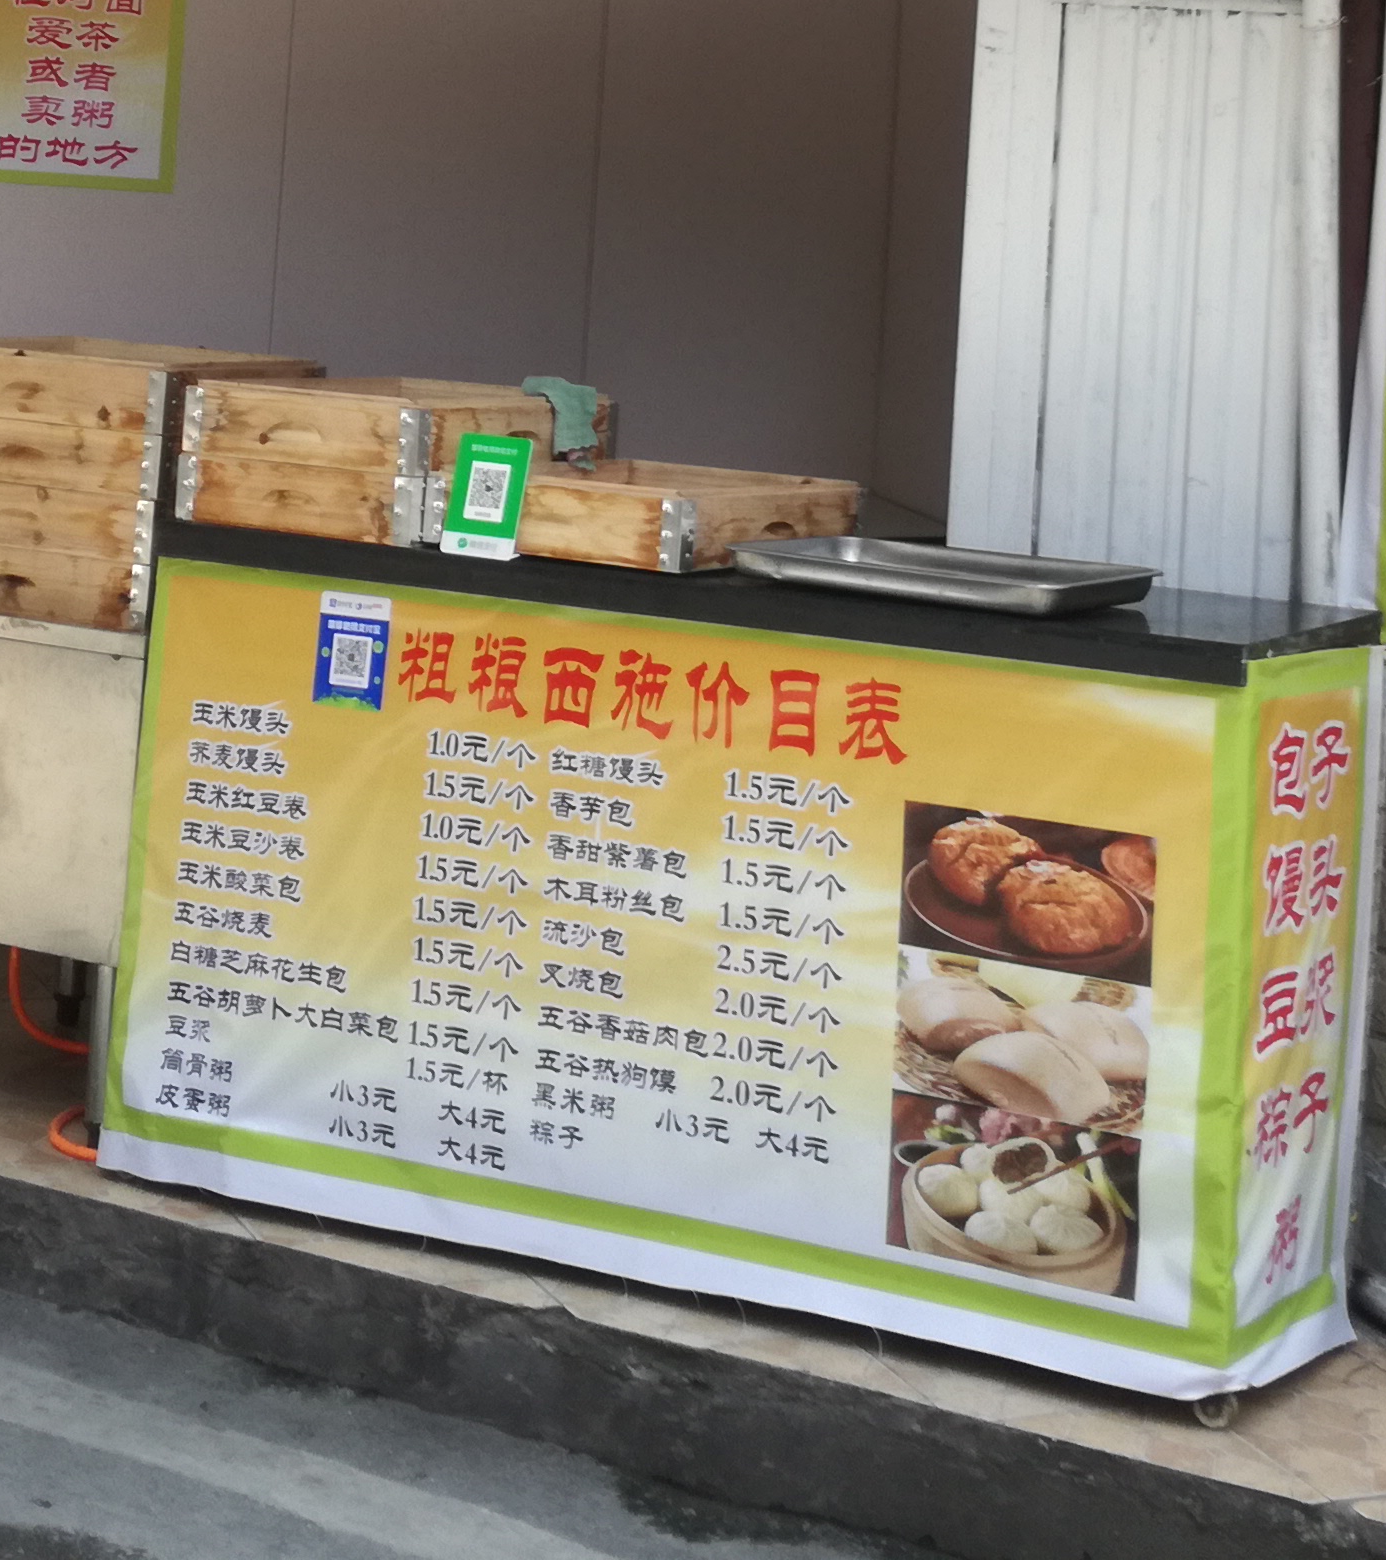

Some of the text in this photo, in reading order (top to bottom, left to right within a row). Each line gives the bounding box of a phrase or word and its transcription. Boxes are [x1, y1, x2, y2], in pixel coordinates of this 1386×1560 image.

[26, 16, 120, 52] 爱茶
[26, 56, 117, 92] 或者
[21, 95, 115, 129] 卖粥
[398, 628, 907, 765] 粗粮西施价目表
[193, 702, 536, 768] 玉米馒头 1.0元/个
[1272, 726, 1348, 814] 包子
[189, 741, 534, 810] 荞麦馒头 1.5元/个
[551, 748, 850, 813] 红糖馒头 1.5元/个
[186, 781, 531, 852] 玉米红豆卷 1.0元/个
[550, 791, 849, 857] 香芋包 1.5元/个
[181, 821, 528, 894] 玉米豆沙卷 1.5元/个
[547, 834, 847, 901] 香甜紫薯包 1.5元/个
[1266, 840, 1345, 930] 馒头
[178, 862, 527, 935] 玉米酸菜包 1.5元/个
[543, 877, 845, 945] 木耳粉丝包 1.5元/个
[174, 902, 523, 978] 五谷烧麦 1.5元/个
[542, 919, 842, 989] 流沙包 2.5元/个
[170, 940, 522, 1020] 白糖芝麻花生包 1.5元/个
[539, 963, 840, 1033] 叉烧包 2.0元/个
[1256, 952, 1335, 1055] 豆浆
[167, 981, 519, 1063] 五谷胡萝卜大白菜包 1.5元/个
[537, 1006, 838, 1077] 五谷香菇肉包 2.0元/个
[160, 1047, 508, 1135] 筒骨粥 小3元 大4元
[406, 1057, 508, 1096] 1.5元/杯
[535, 1048, 837, 1122] 五谷热狗馍 2.0元/个
[155, 1083, 506, 1171] 皮蛋粥 小3元 大4元
[529, 1119, 584, 1150] 粽子
[531, 1082, 830, 1164] 黑米粥 小3元 大4元
[1253, 1072, 1329, 1168] 粽子
